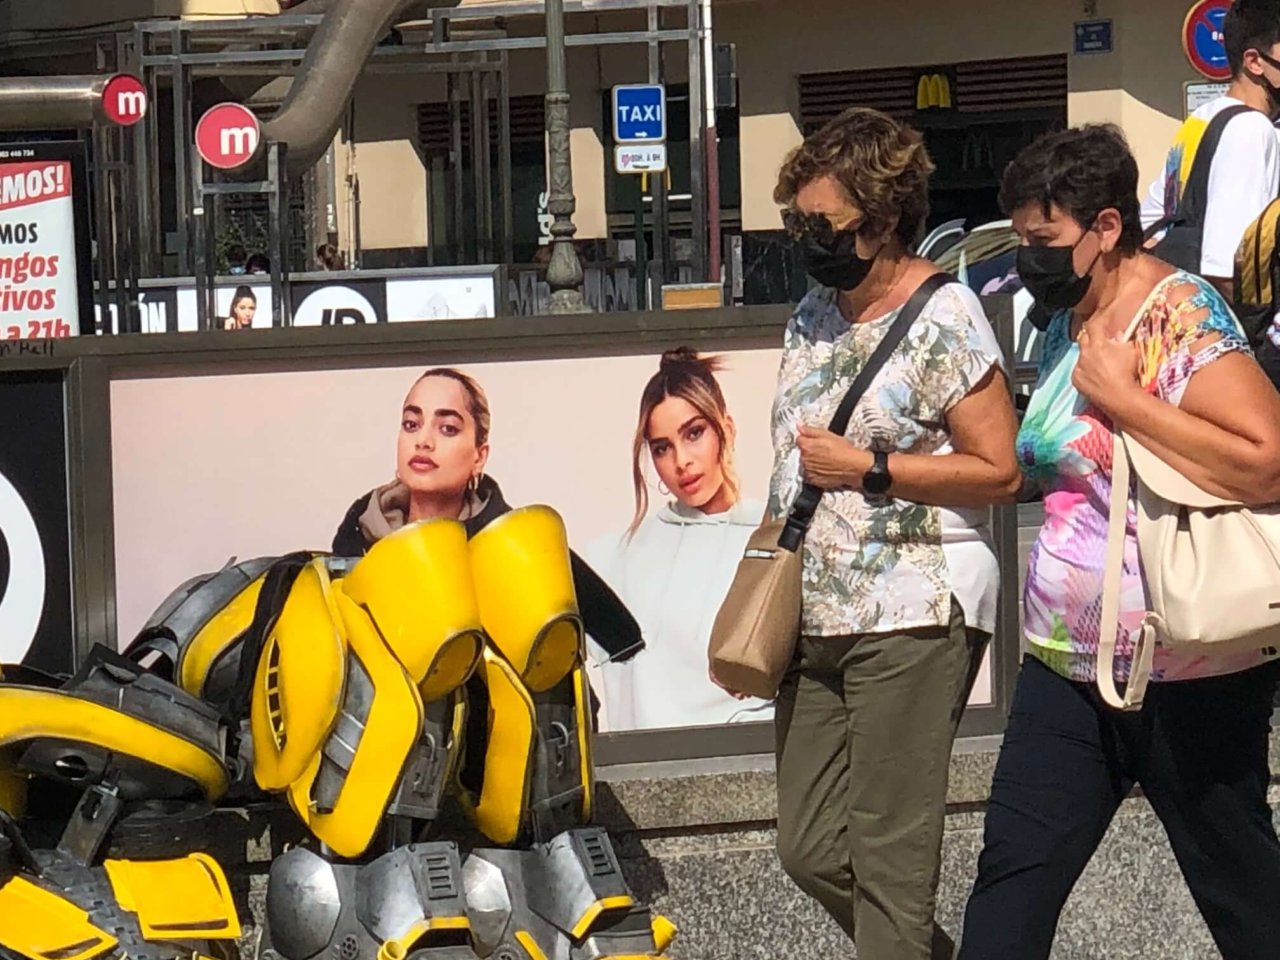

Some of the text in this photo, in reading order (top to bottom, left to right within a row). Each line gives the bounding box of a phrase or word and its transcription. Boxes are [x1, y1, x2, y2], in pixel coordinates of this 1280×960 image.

[118, 91, 146, 116] m
[618, 105, 661, 122] TAXI
[220, 126, 257, 155] m
